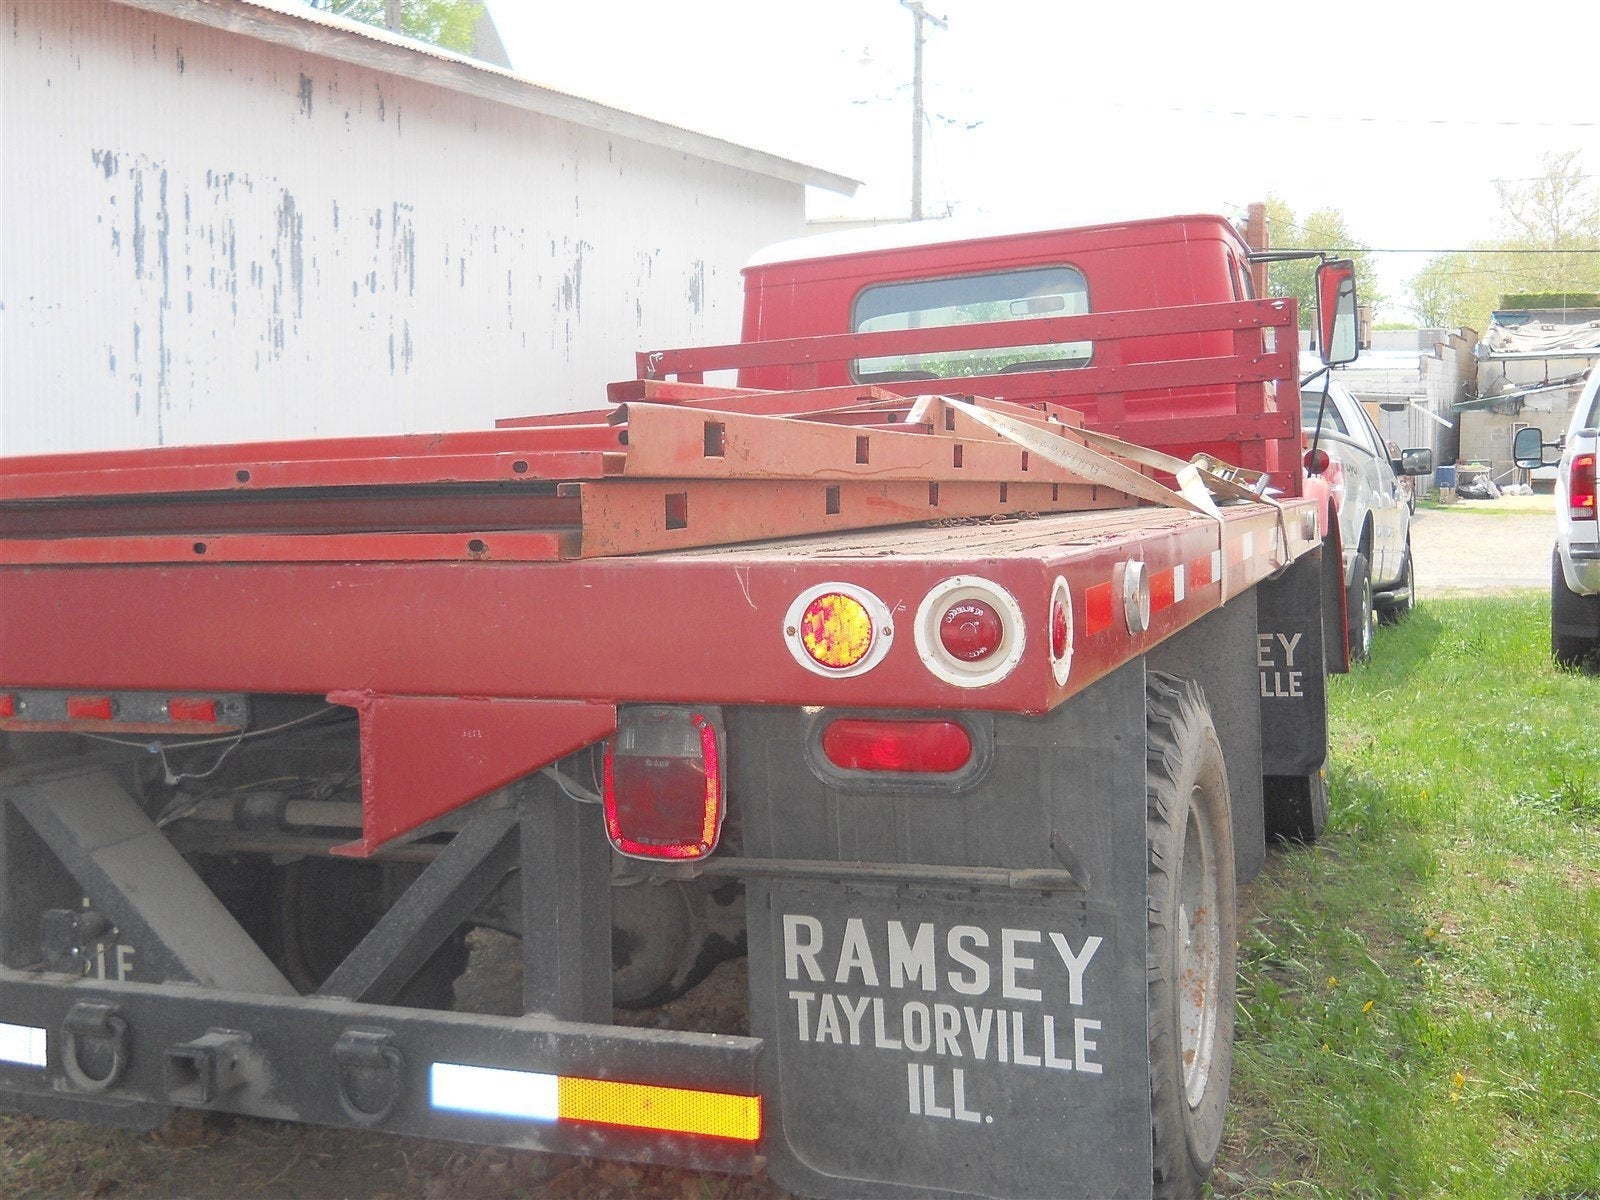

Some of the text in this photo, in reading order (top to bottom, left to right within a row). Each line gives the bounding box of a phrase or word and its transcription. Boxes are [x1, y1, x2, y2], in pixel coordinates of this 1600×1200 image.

[783, 914, 1103, 1005] RAMSEY
[789, 990, 1103, 1073] TAYLORVILLE
[908, 1063, 994, 1123] ILL.
